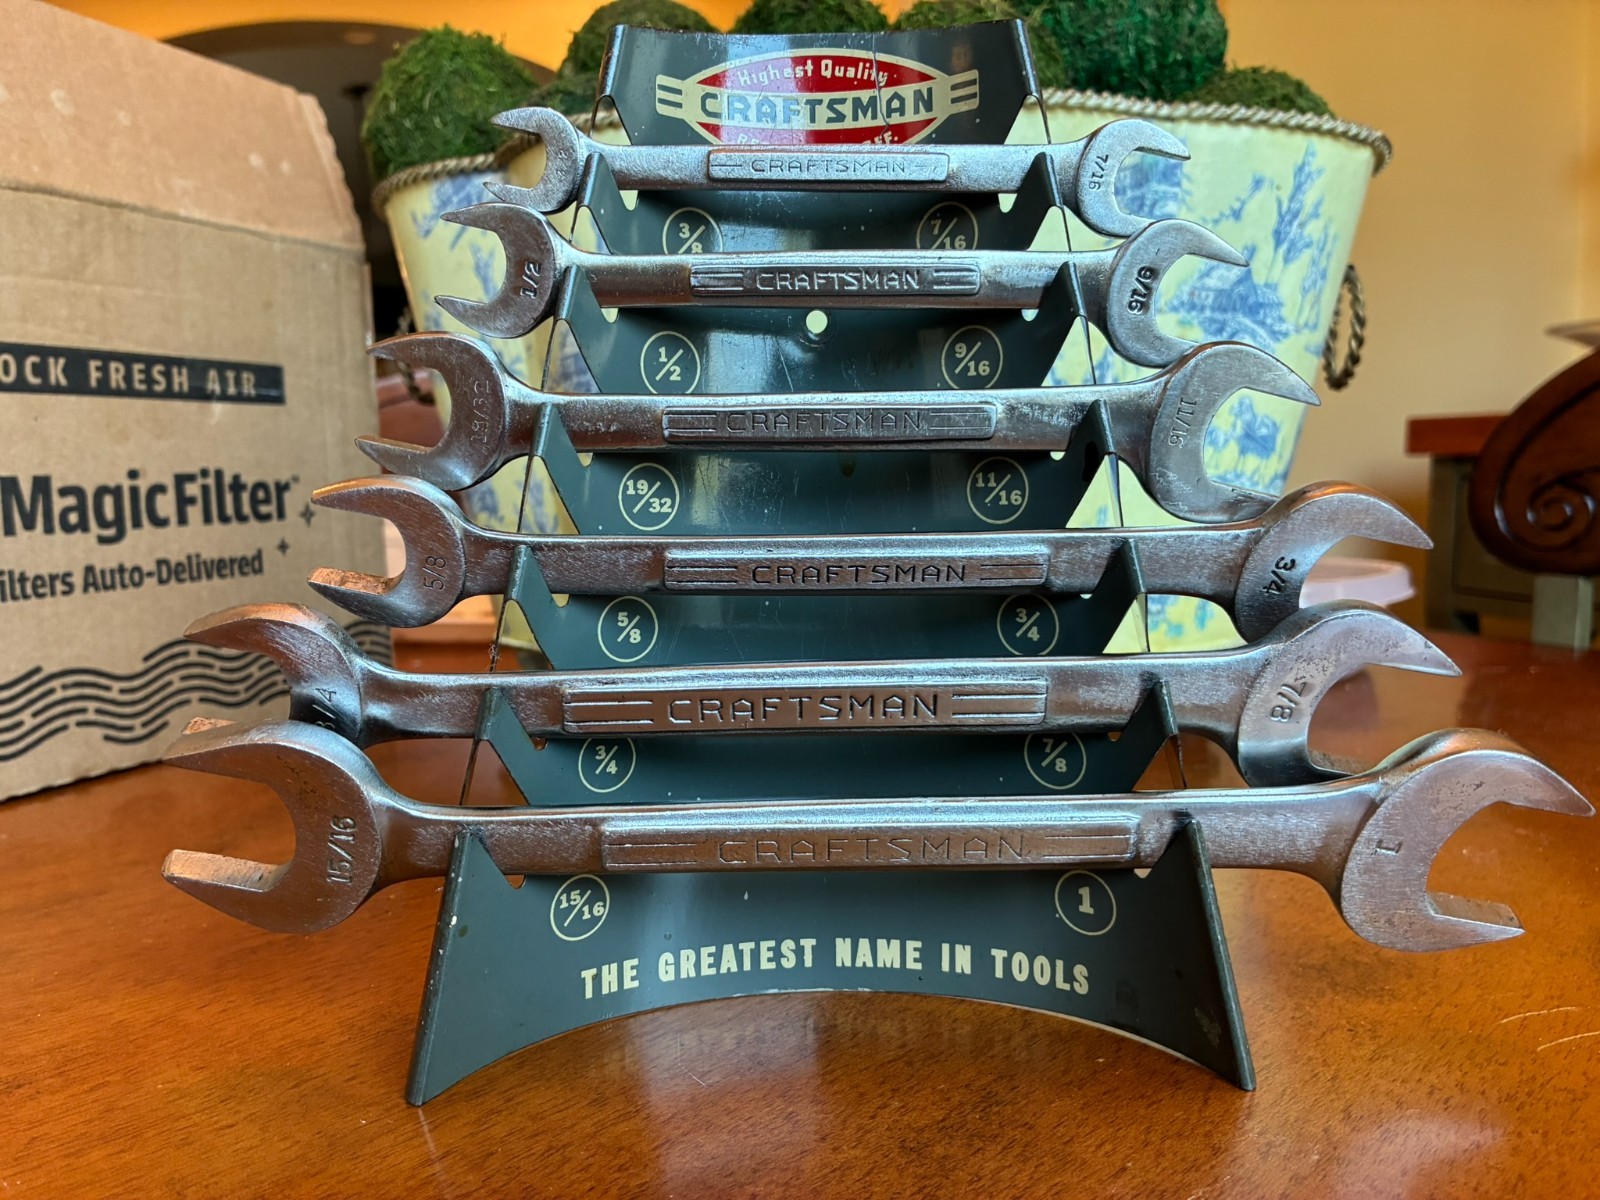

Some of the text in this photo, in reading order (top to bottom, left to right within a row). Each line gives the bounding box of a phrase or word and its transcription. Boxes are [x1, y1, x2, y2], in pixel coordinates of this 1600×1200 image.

[738, 59, 888, 87] Highest Quality
[700, 86, 933, 124] CRAFTSMAN
[750, 158, 906, 175] CRAFTSMAN
[1088, 153, 1110, 191] 7/16
[930, 216, 967, 250] 7/16
[520, 261, 542, 299] 1/2
[755, 269, 920, 291] CRAFTSMAN
[1127, 265, 1155, 315] 9/16
[0, 353, 258, 398] OCK FRESH AIR
[655, 347, 684, 382] 1/2
[953, 341, 991, 377] 9/16
[725, 410, 922, 433] CRAFTSMAN
[1, 468, 290, 545] MagicFilter
[625, 478, 673, 514] 19/32
[974, 471, 1022, 506] 11/16
[0, 549, 264, 602] ilters Auto-Delivered
[422, 555, 447, 591] 5/8
[751, 563, 966, 585] CRAFTSMAN
[1262, 555, 1297, 595] 3/4
[616, 611, 641, 645] 5/8
[1015, 606, 1040, 642] 3/4
[666, 692, 940, 725] CRAFTSMAN
[1270, 680, 1307, 723] 7/8
[594, 744, 619, 776] 3/4
[1041, 737, 1068, 774] 7/8
[326, 815, 357, 885] 15/16
[718, 835, 1025, 864] CRAFTSMAN
[559, 888, 605, 927] 15/16
[1076, 886, 1095, 916] 1
[581, 937, 1089, 1000] THE GREATEST NAME IN TOOLS
